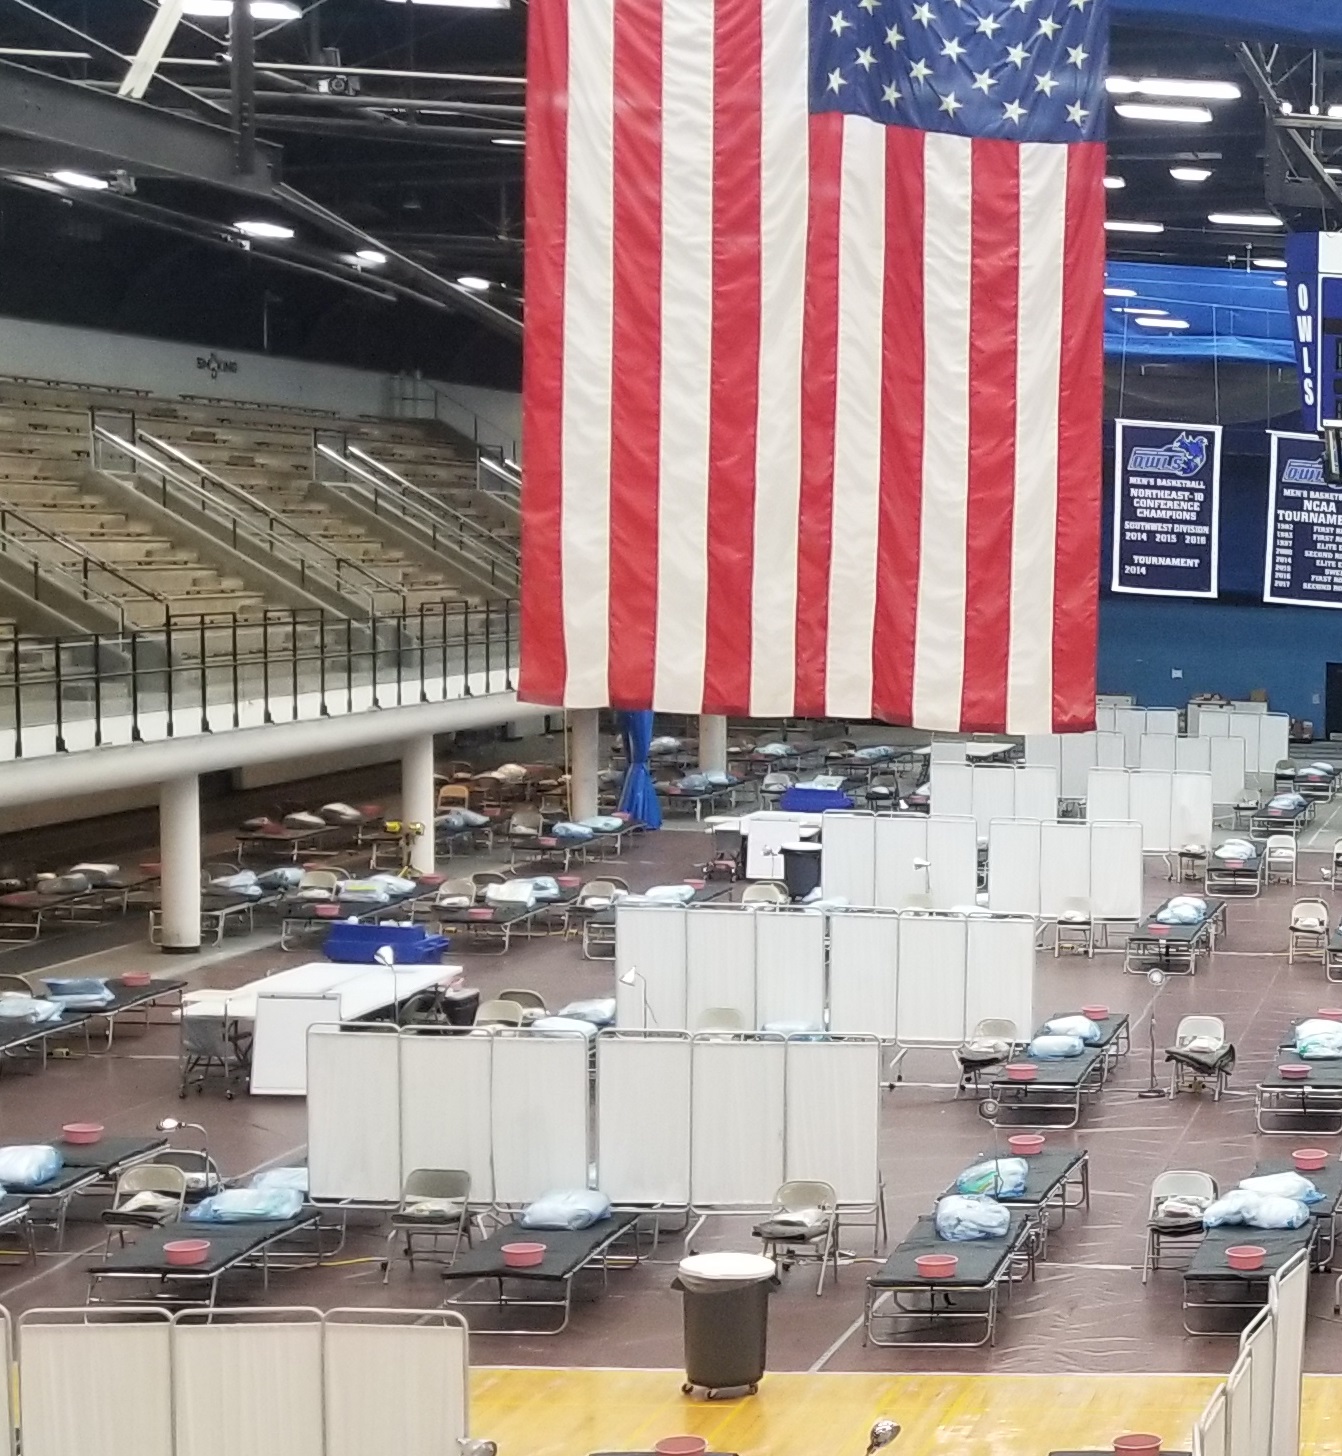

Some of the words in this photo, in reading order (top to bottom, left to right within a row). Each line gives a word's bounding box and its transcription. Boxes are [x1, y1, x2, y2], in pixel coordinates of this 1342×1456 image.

[1297, 283, 1314, 406] OWLS
[1157, 478, 1205, 489] BASKETBALL
[1130, 488, 1204, 501] NORTHEAST-10
[1133, 498, 1200, 511] CONFERENCE
[1303, 500, 1336, 512] NCAA
[1136, 508, 1197, 520] CHAMPIONS
[1124, 521, 1172, 532] SOUTHWEST
[1174, 524, 1209, 534] DIVISION
[1125, 532, 1147, 541] 2014
[1155, 534, 1177, 543] 2015
[1132, 555, 1200, 567] TOURNAMENT
[1124, 565, 1146, 575] 2014
